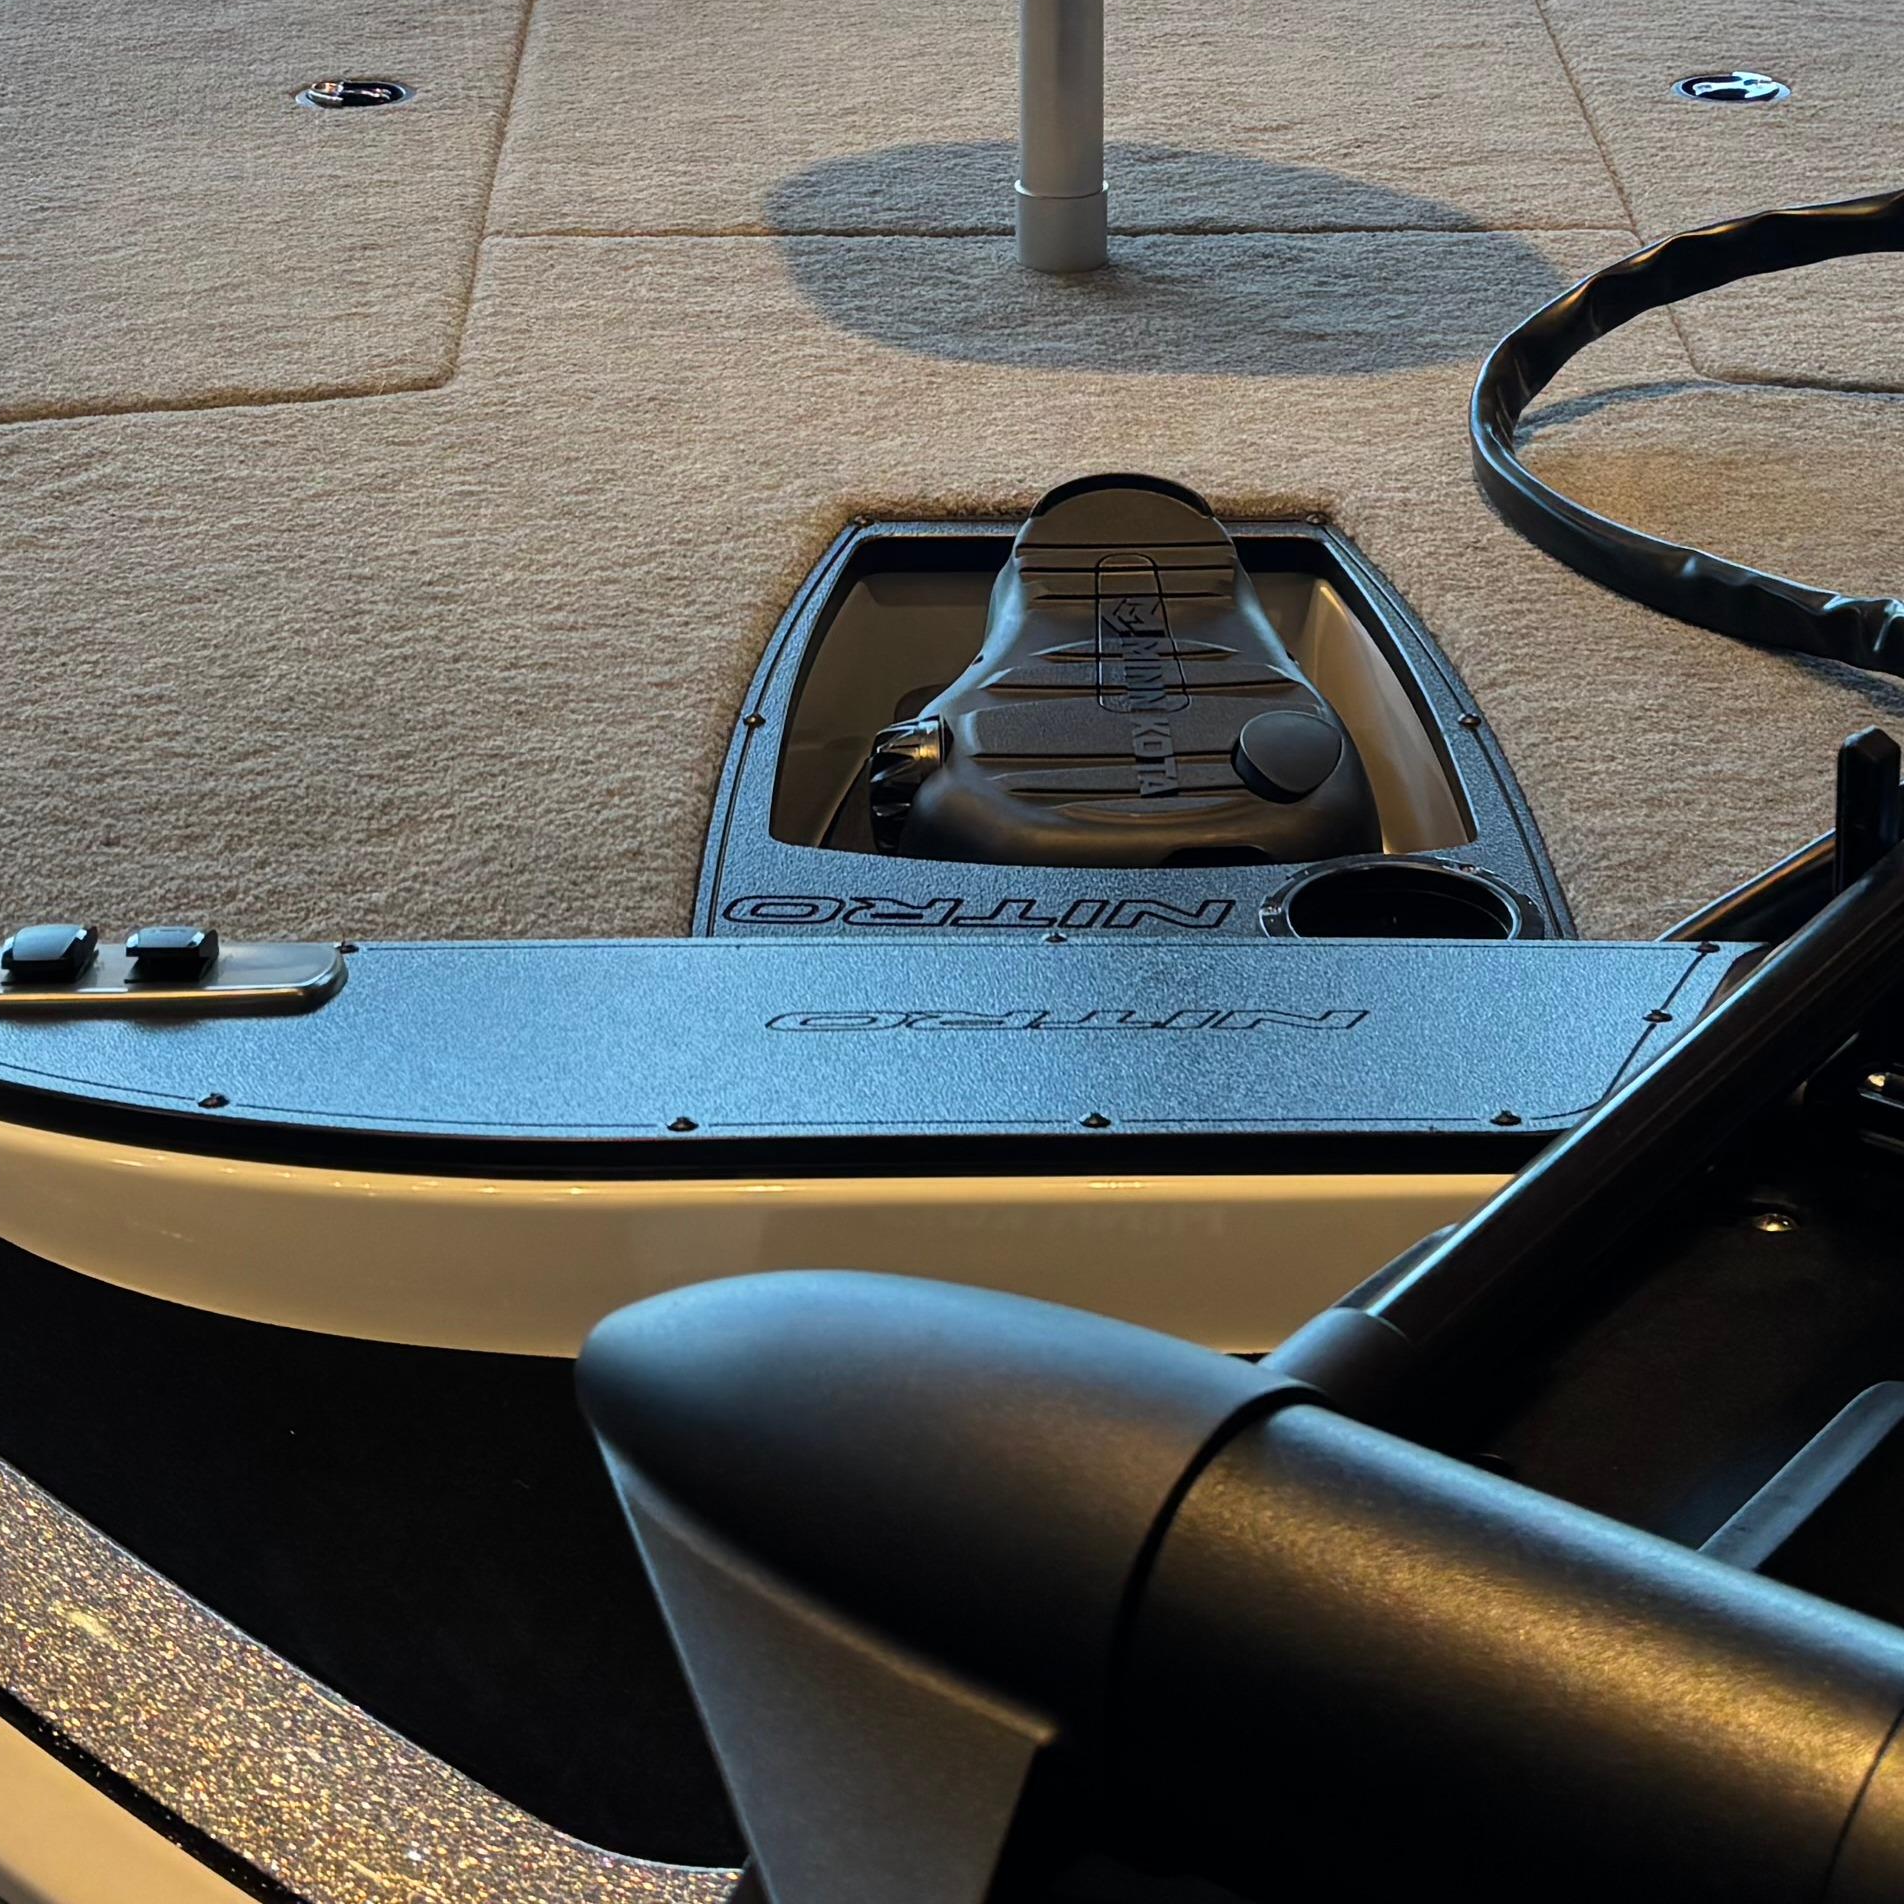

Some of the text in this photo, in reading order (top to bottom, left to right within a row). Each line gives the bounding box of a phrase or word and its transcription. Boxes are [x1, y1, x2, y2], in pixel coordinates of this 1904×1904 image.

[1130, 715, 1179, 797] KOTA
[723, 895, 1235, 930] NITRO
[765, 1009, 1371, 1033] NITRO
